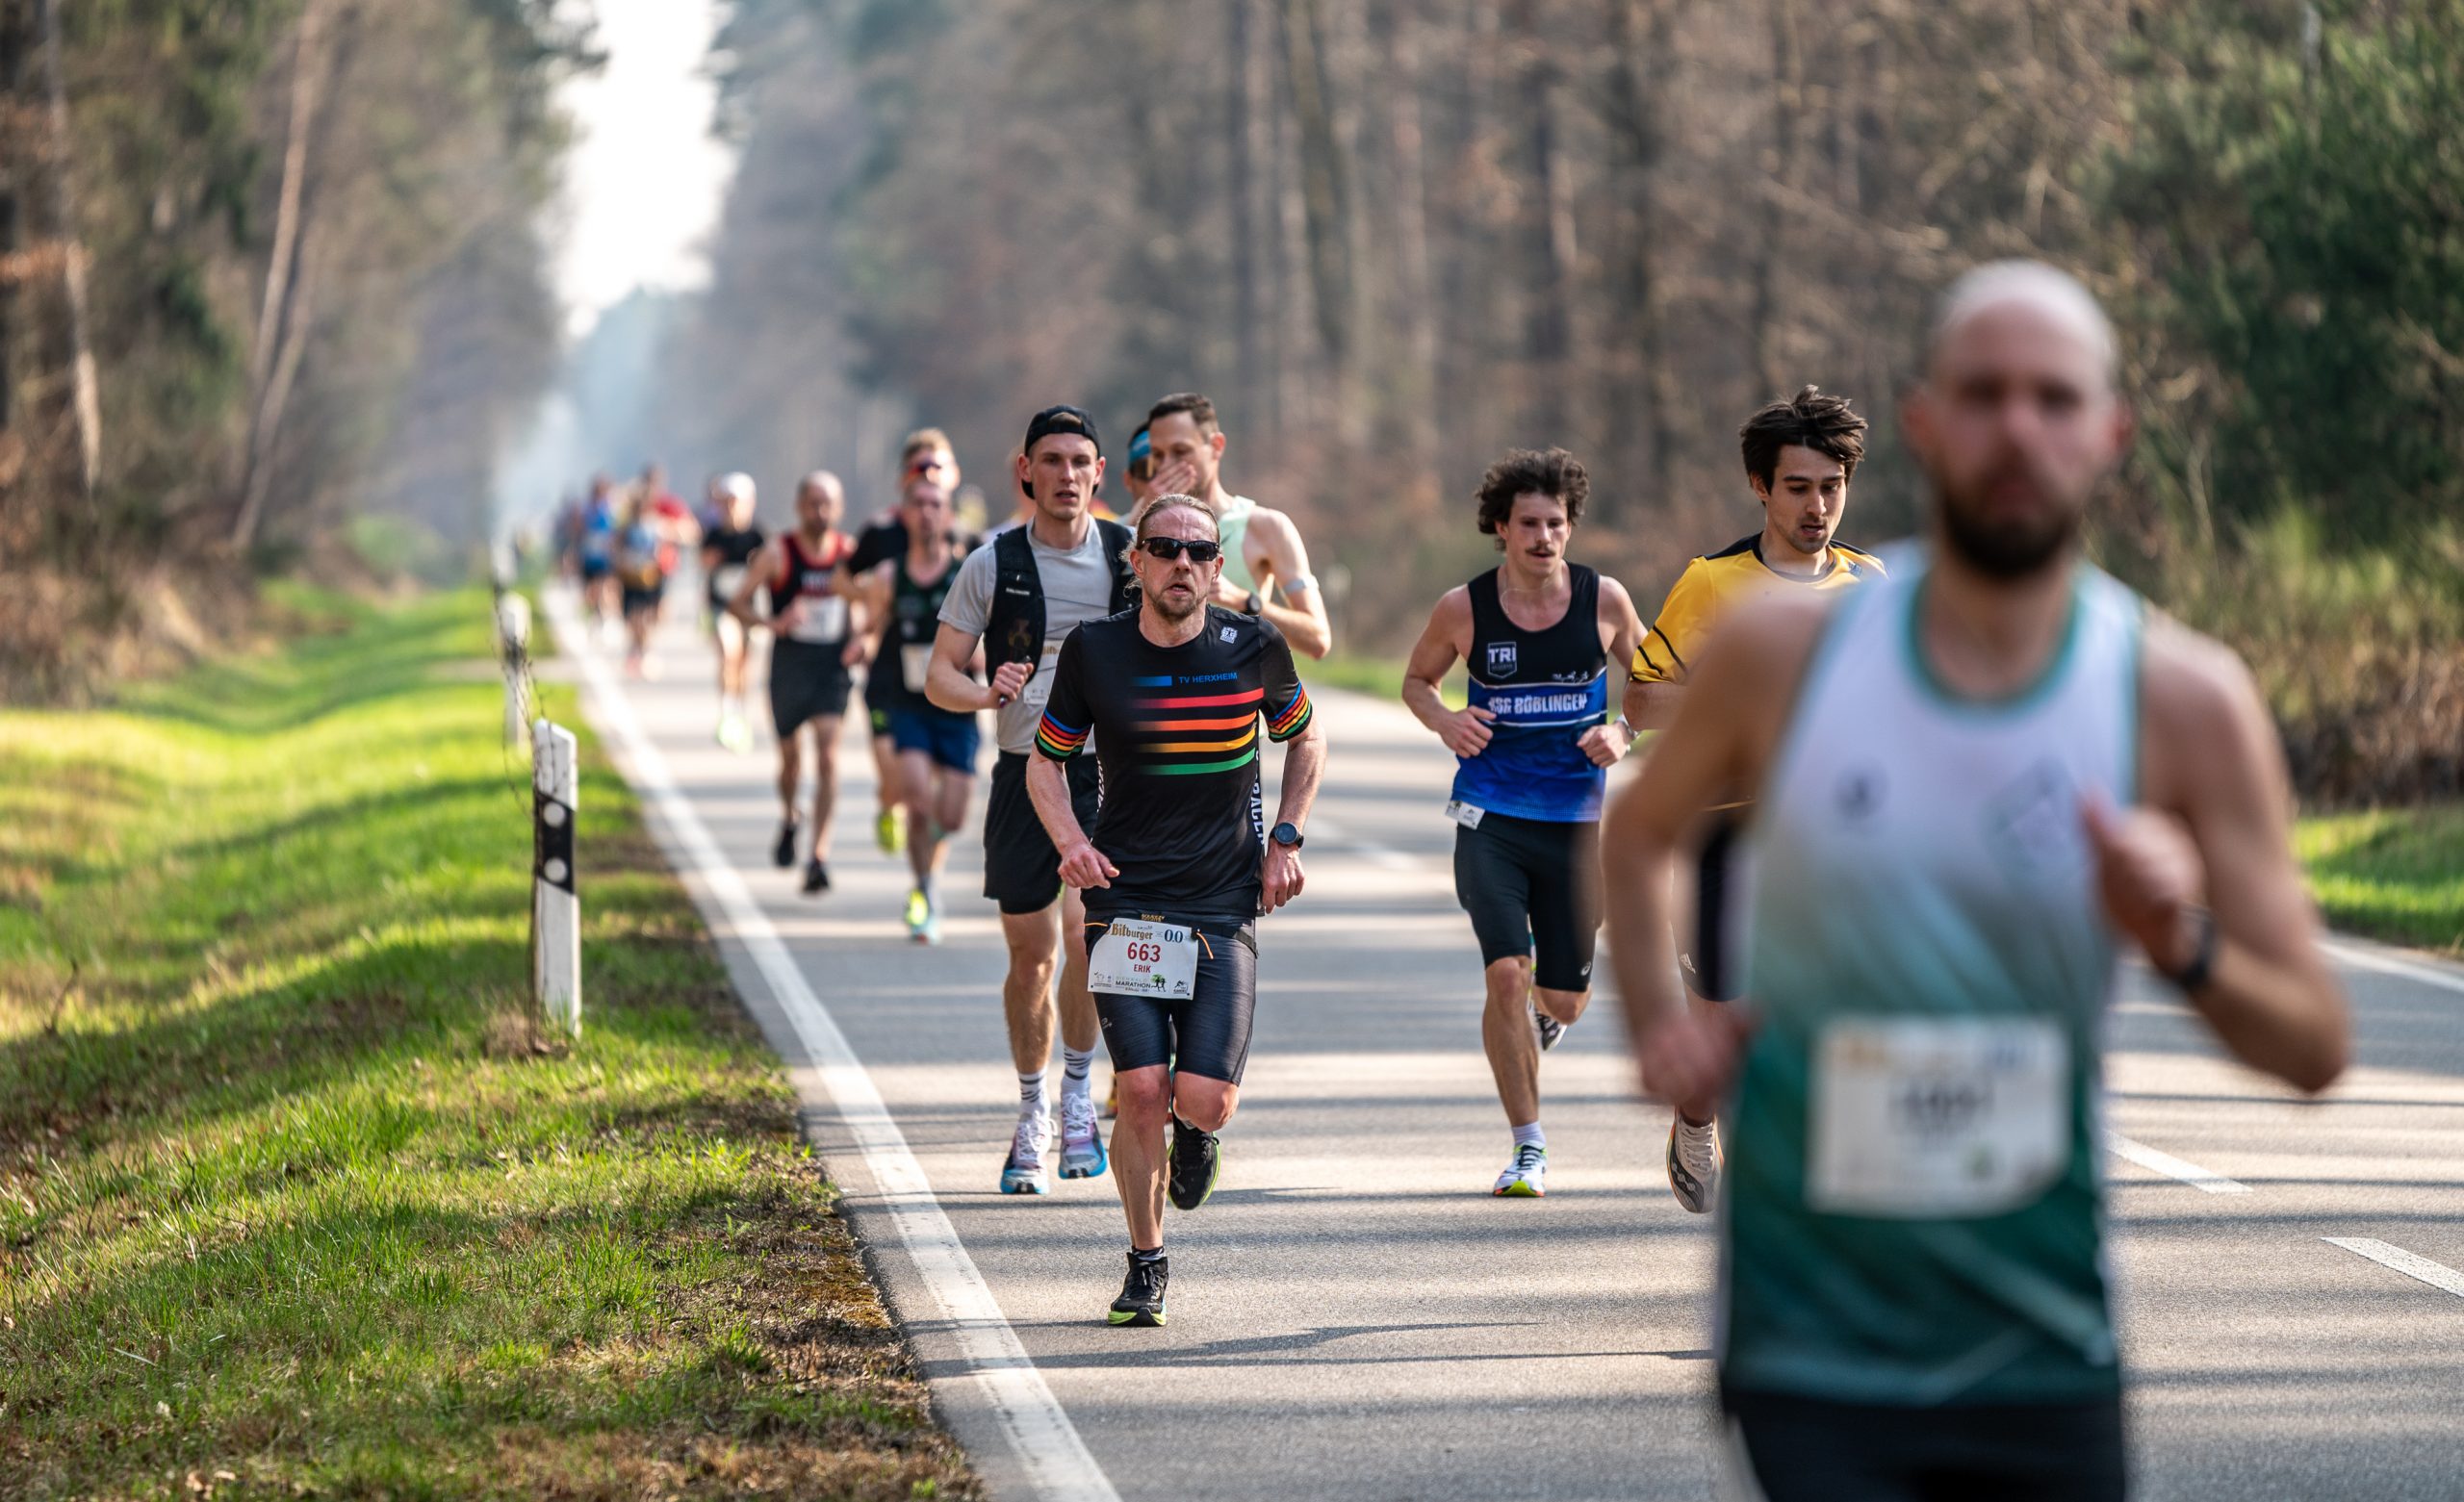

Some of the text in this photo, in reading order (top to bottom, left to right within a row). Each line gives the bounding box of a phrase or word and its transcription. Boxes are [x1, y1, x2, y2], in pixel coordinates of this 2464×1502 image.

[1488, 647, 1517, 664] TRI
[1192, 672, 1239, 683] HERXHEIM
[1514, 693, 1587, 714] BÖBLINGEN
[1111, 923, 1153, 940] Bitburger
[1164, 929, 1184, 943] 0.0
[1127, 942, 1161, 962] 663
[1134, 964, 1151, 973] ERIK
